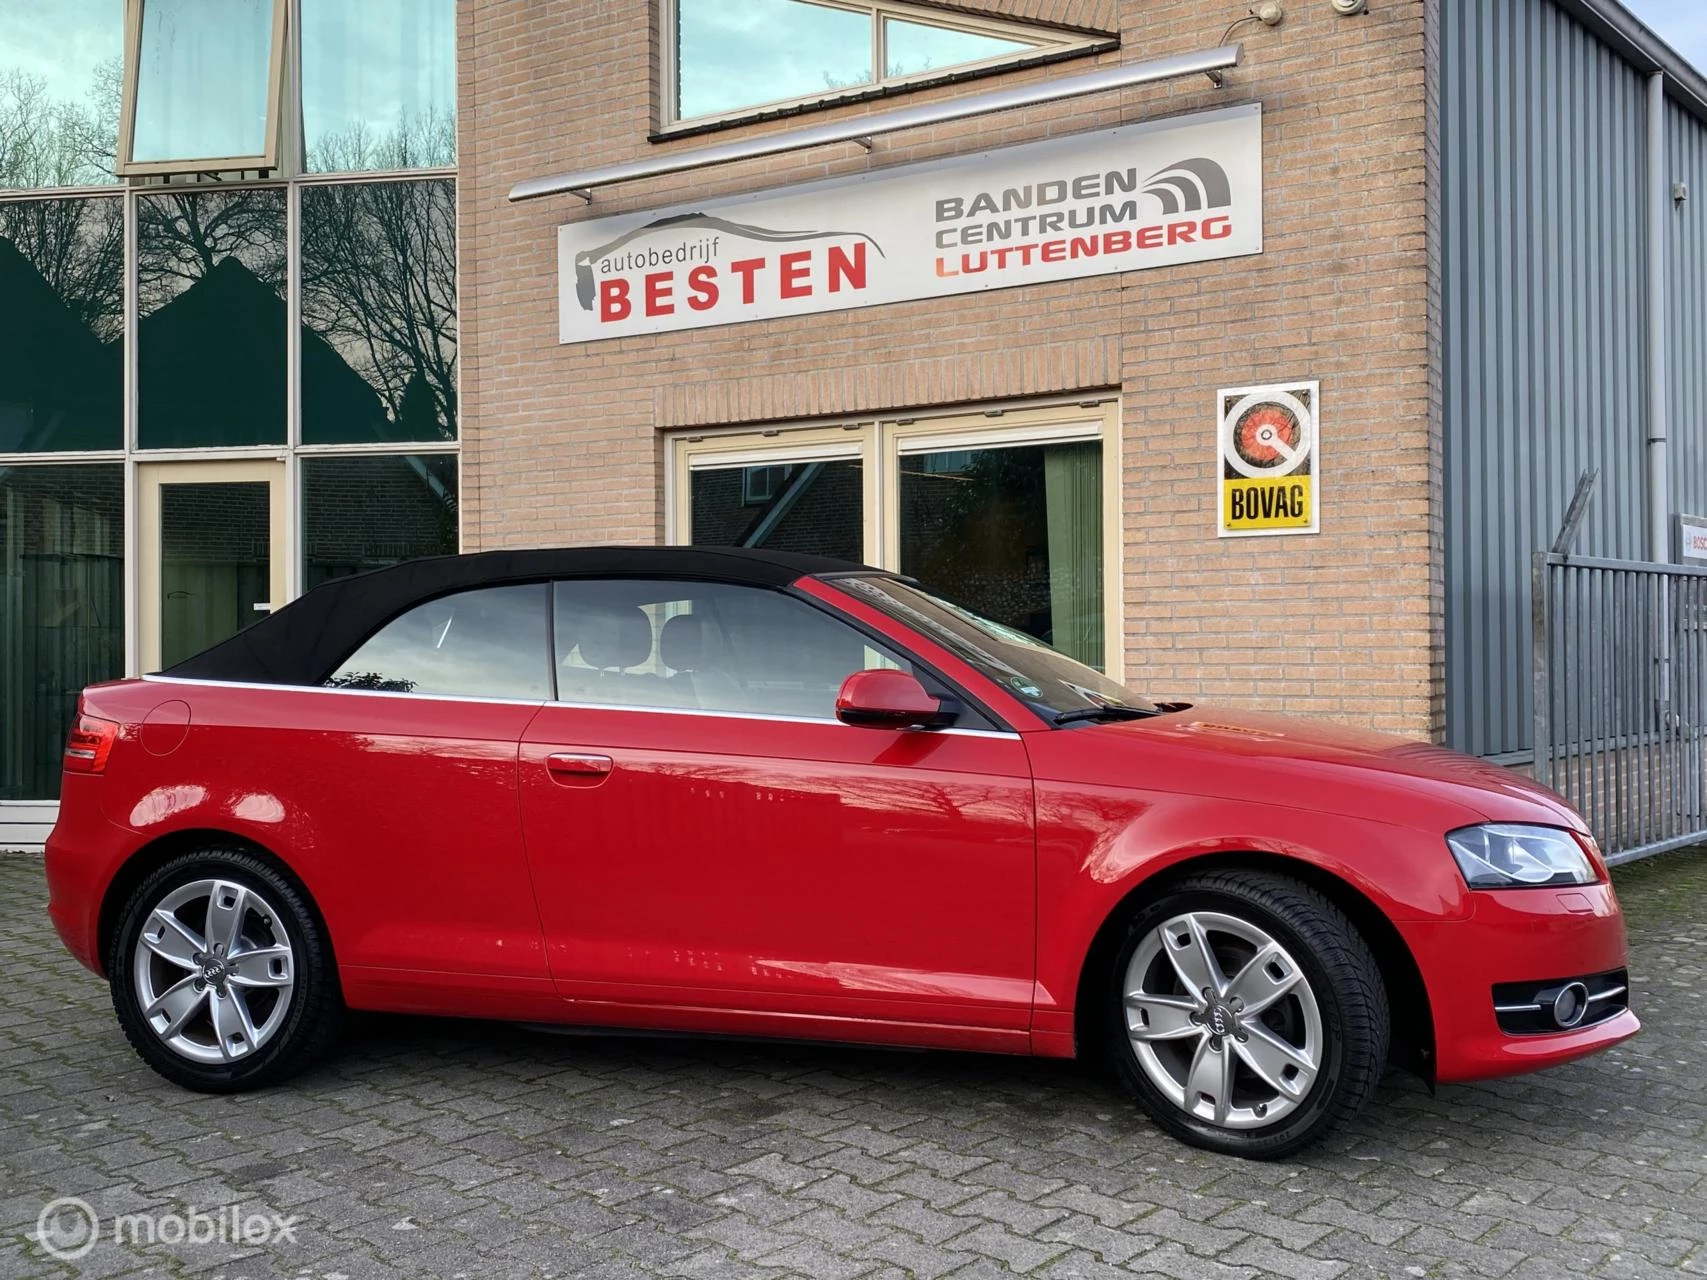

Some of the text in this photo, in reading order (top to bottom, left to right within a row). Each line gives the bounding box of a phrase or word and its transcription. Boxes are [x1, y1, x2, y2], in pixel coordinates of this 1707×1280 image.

[935, 167, 1137, 223] BANDEN
[935, 200, 1137, 250] CENTRUM
[935, 215, 1232, 278] LUTTENBERG
[600, 236, 720, 274] autobedrijf
[600, 242, 867, 323] BESTEN
[1231, 484, 1304, 520] BOVAG
